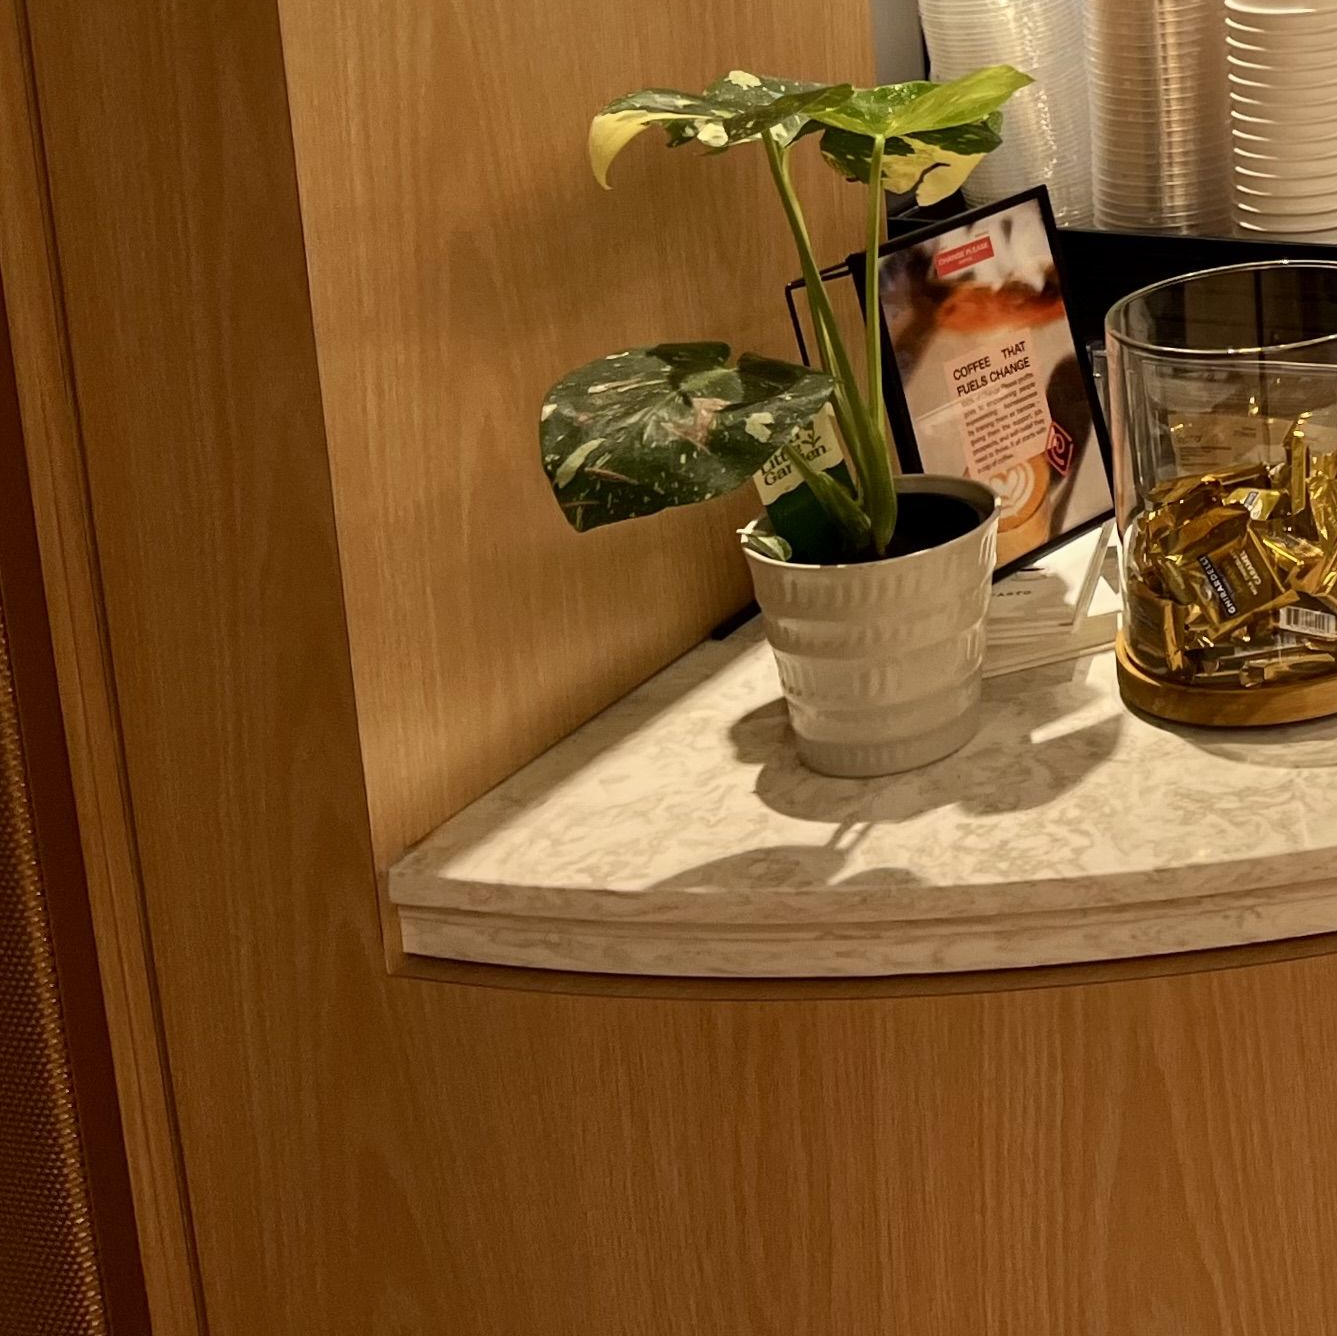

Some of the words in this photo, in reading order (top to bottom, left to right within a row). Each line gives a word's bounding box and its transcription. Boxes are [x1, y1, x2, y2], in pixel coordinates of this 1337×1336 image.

[953, 356, 992, 381] COFFEE
[1001, 341, 1026, 360] THAT
[956, 375, 989, 398] FUELS
[989, 356, 1031, 383] CHANGE
